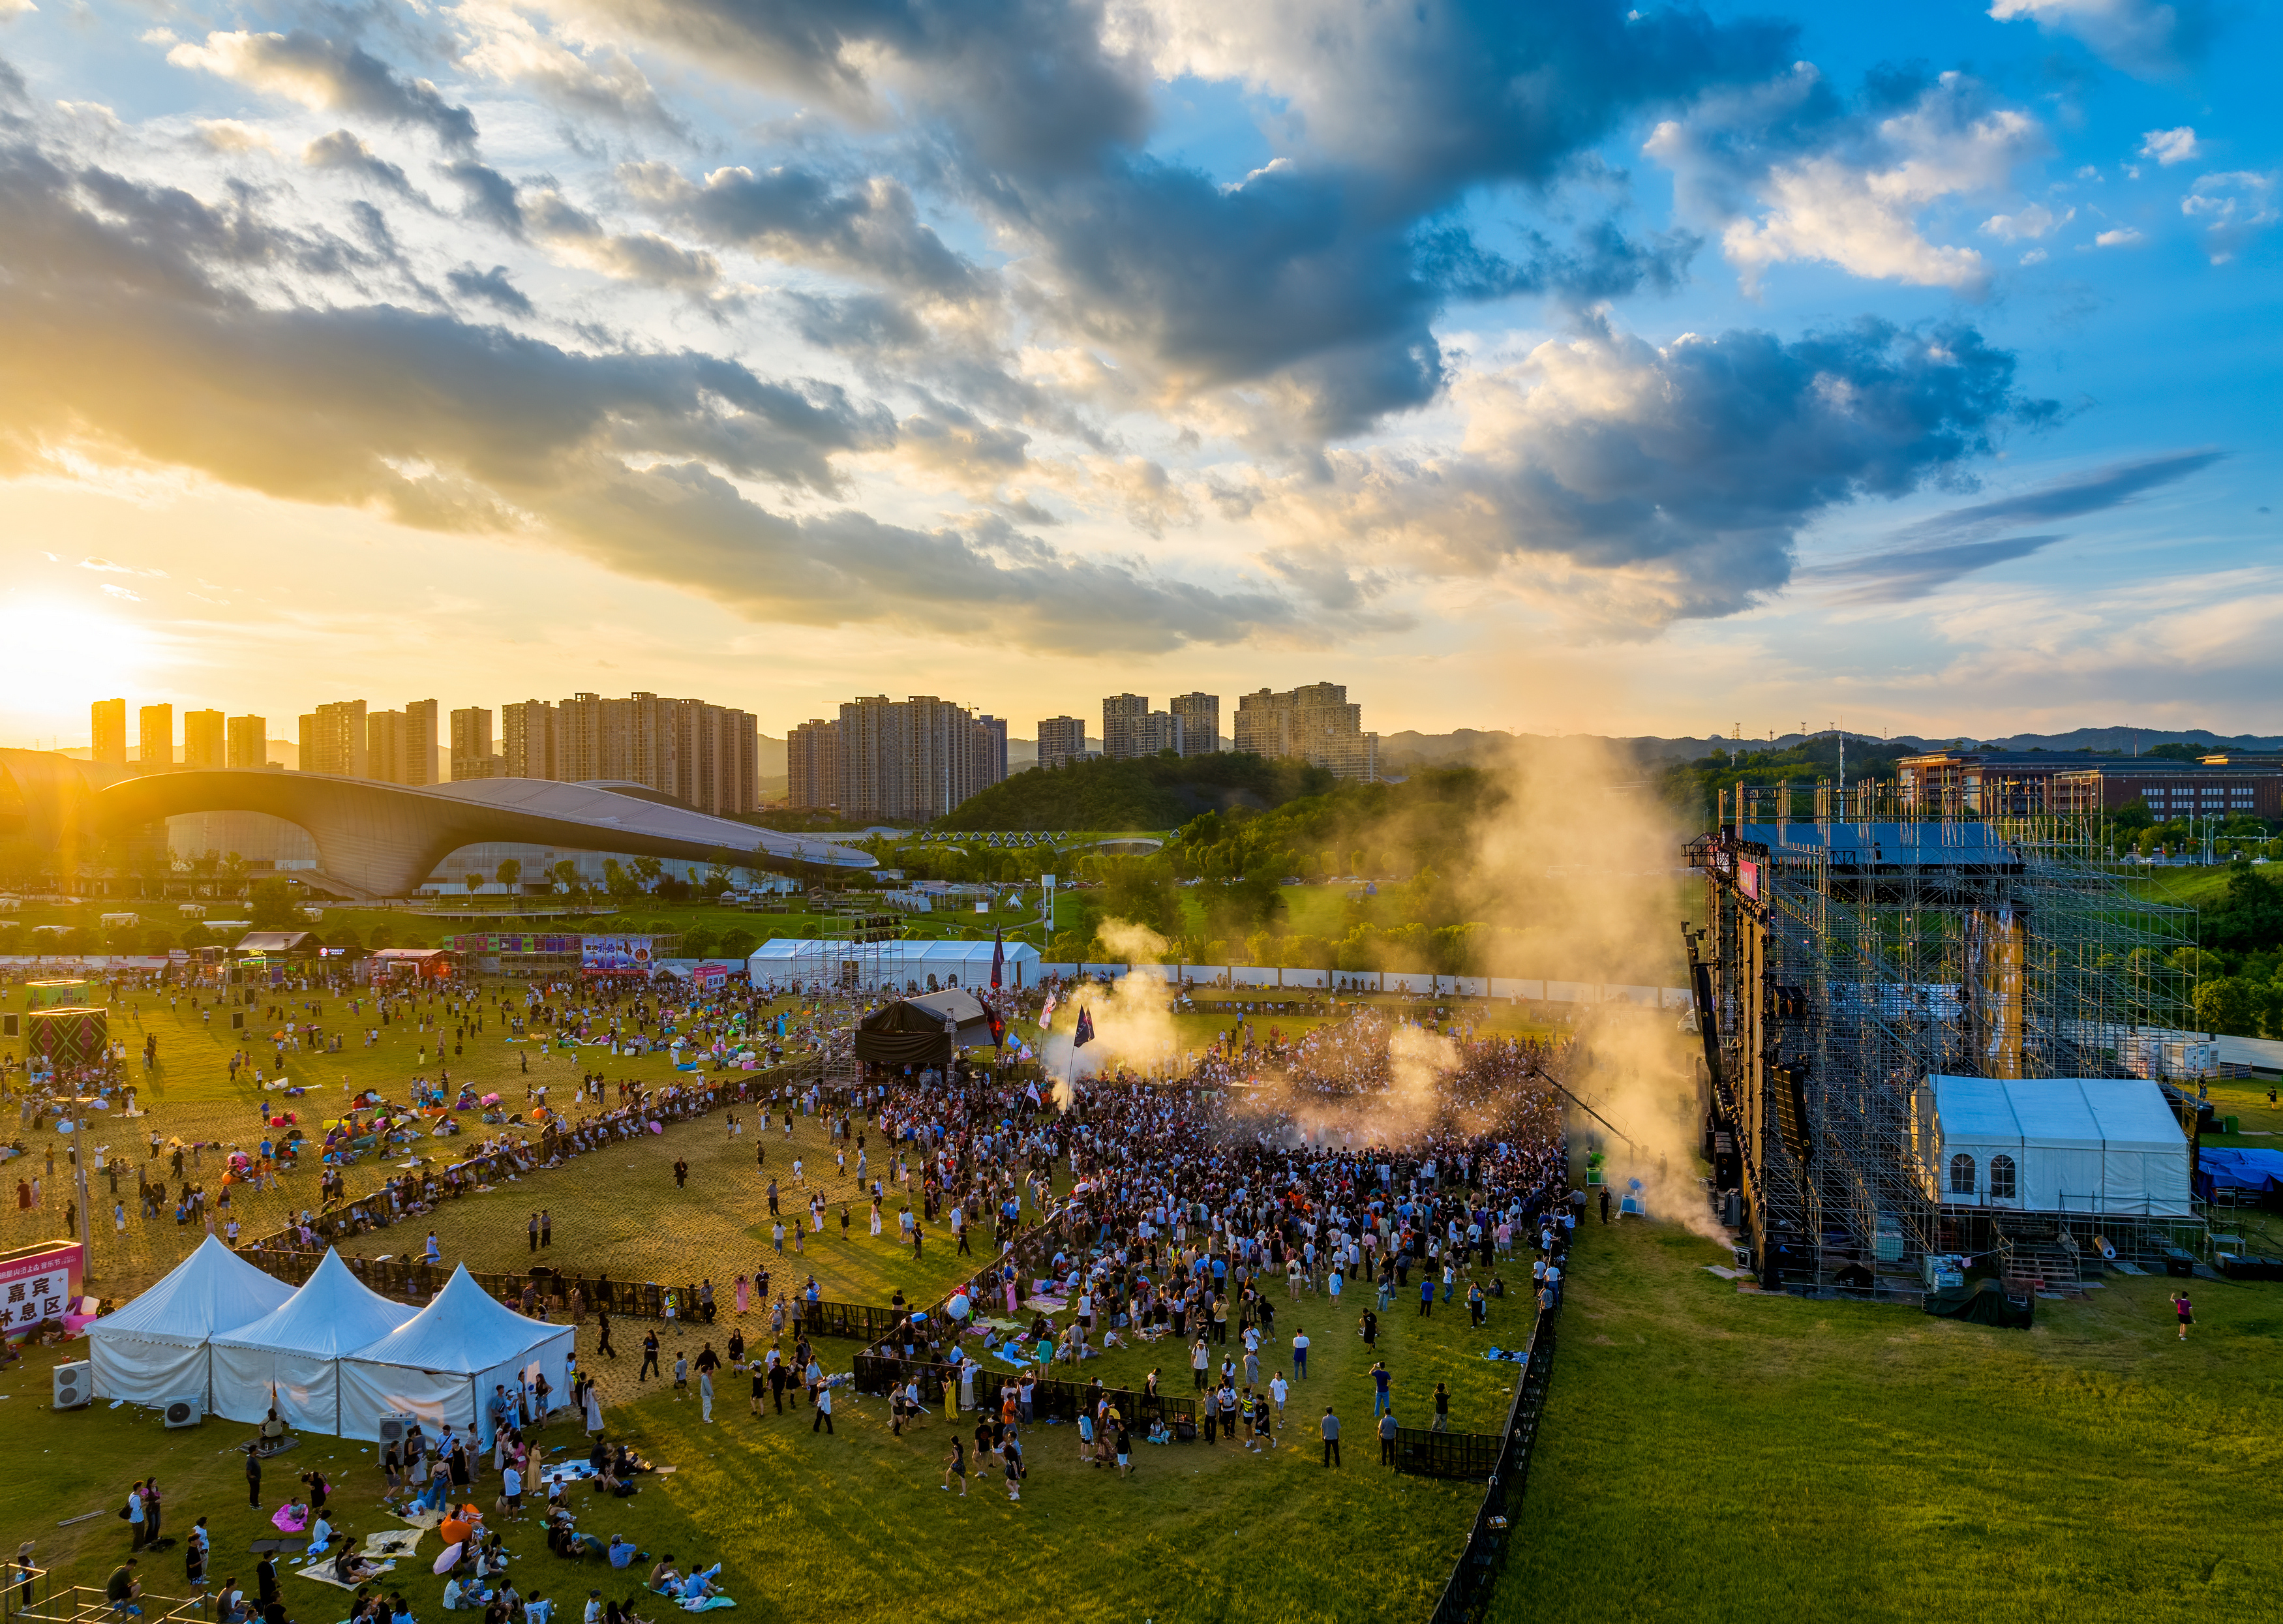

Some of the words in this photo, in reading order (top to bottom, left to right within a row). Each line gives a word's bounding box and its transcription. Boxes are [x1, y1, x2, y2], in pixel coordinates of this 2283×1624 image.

[8, 1277, 50, 1304] 嘉宾
[0, 1295, 61, 1327] 休息区
